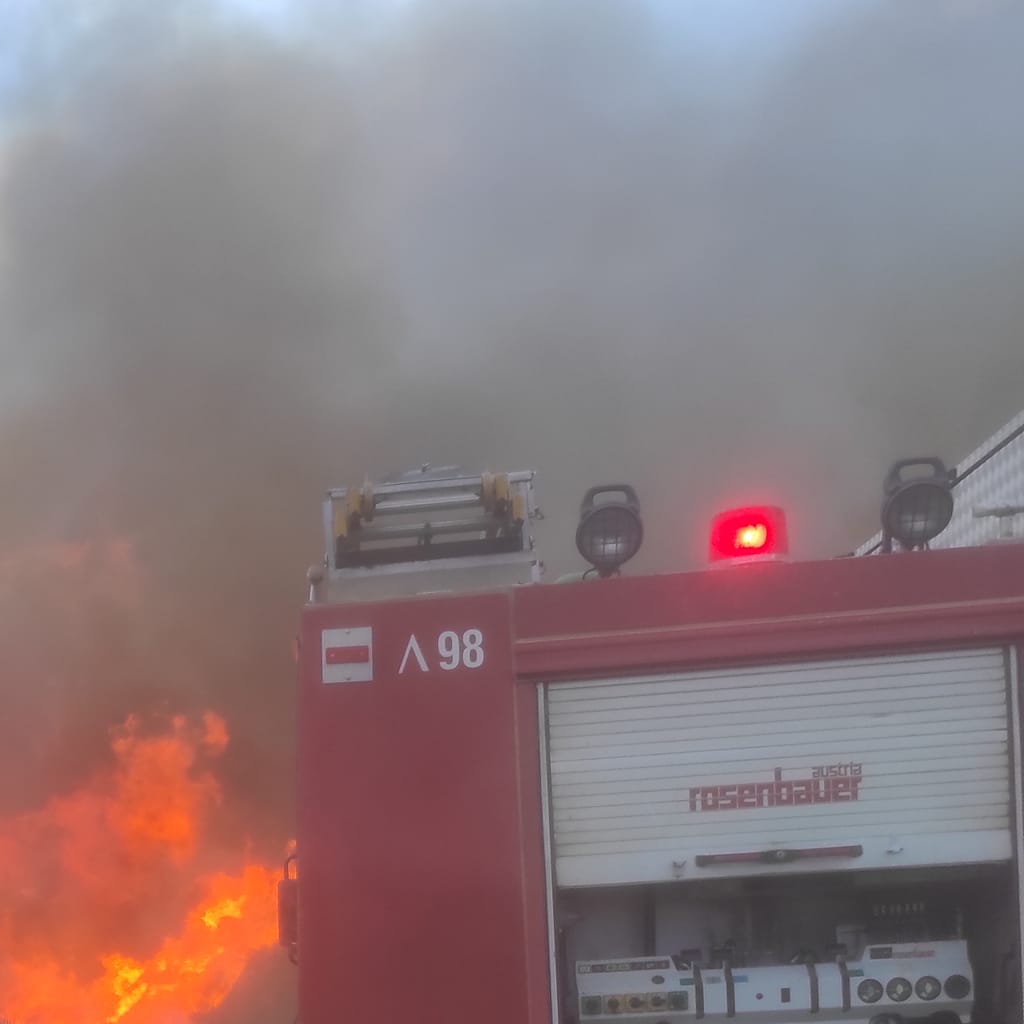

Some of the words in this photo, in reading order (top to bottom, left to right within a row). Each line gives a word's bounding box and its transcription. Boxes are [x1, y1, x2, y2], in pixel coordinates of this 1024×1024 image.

[438, 628, 485, 670] 98
[689, 767, 863, 812] rosenbauer
[811, 762, 863, 779] austria
